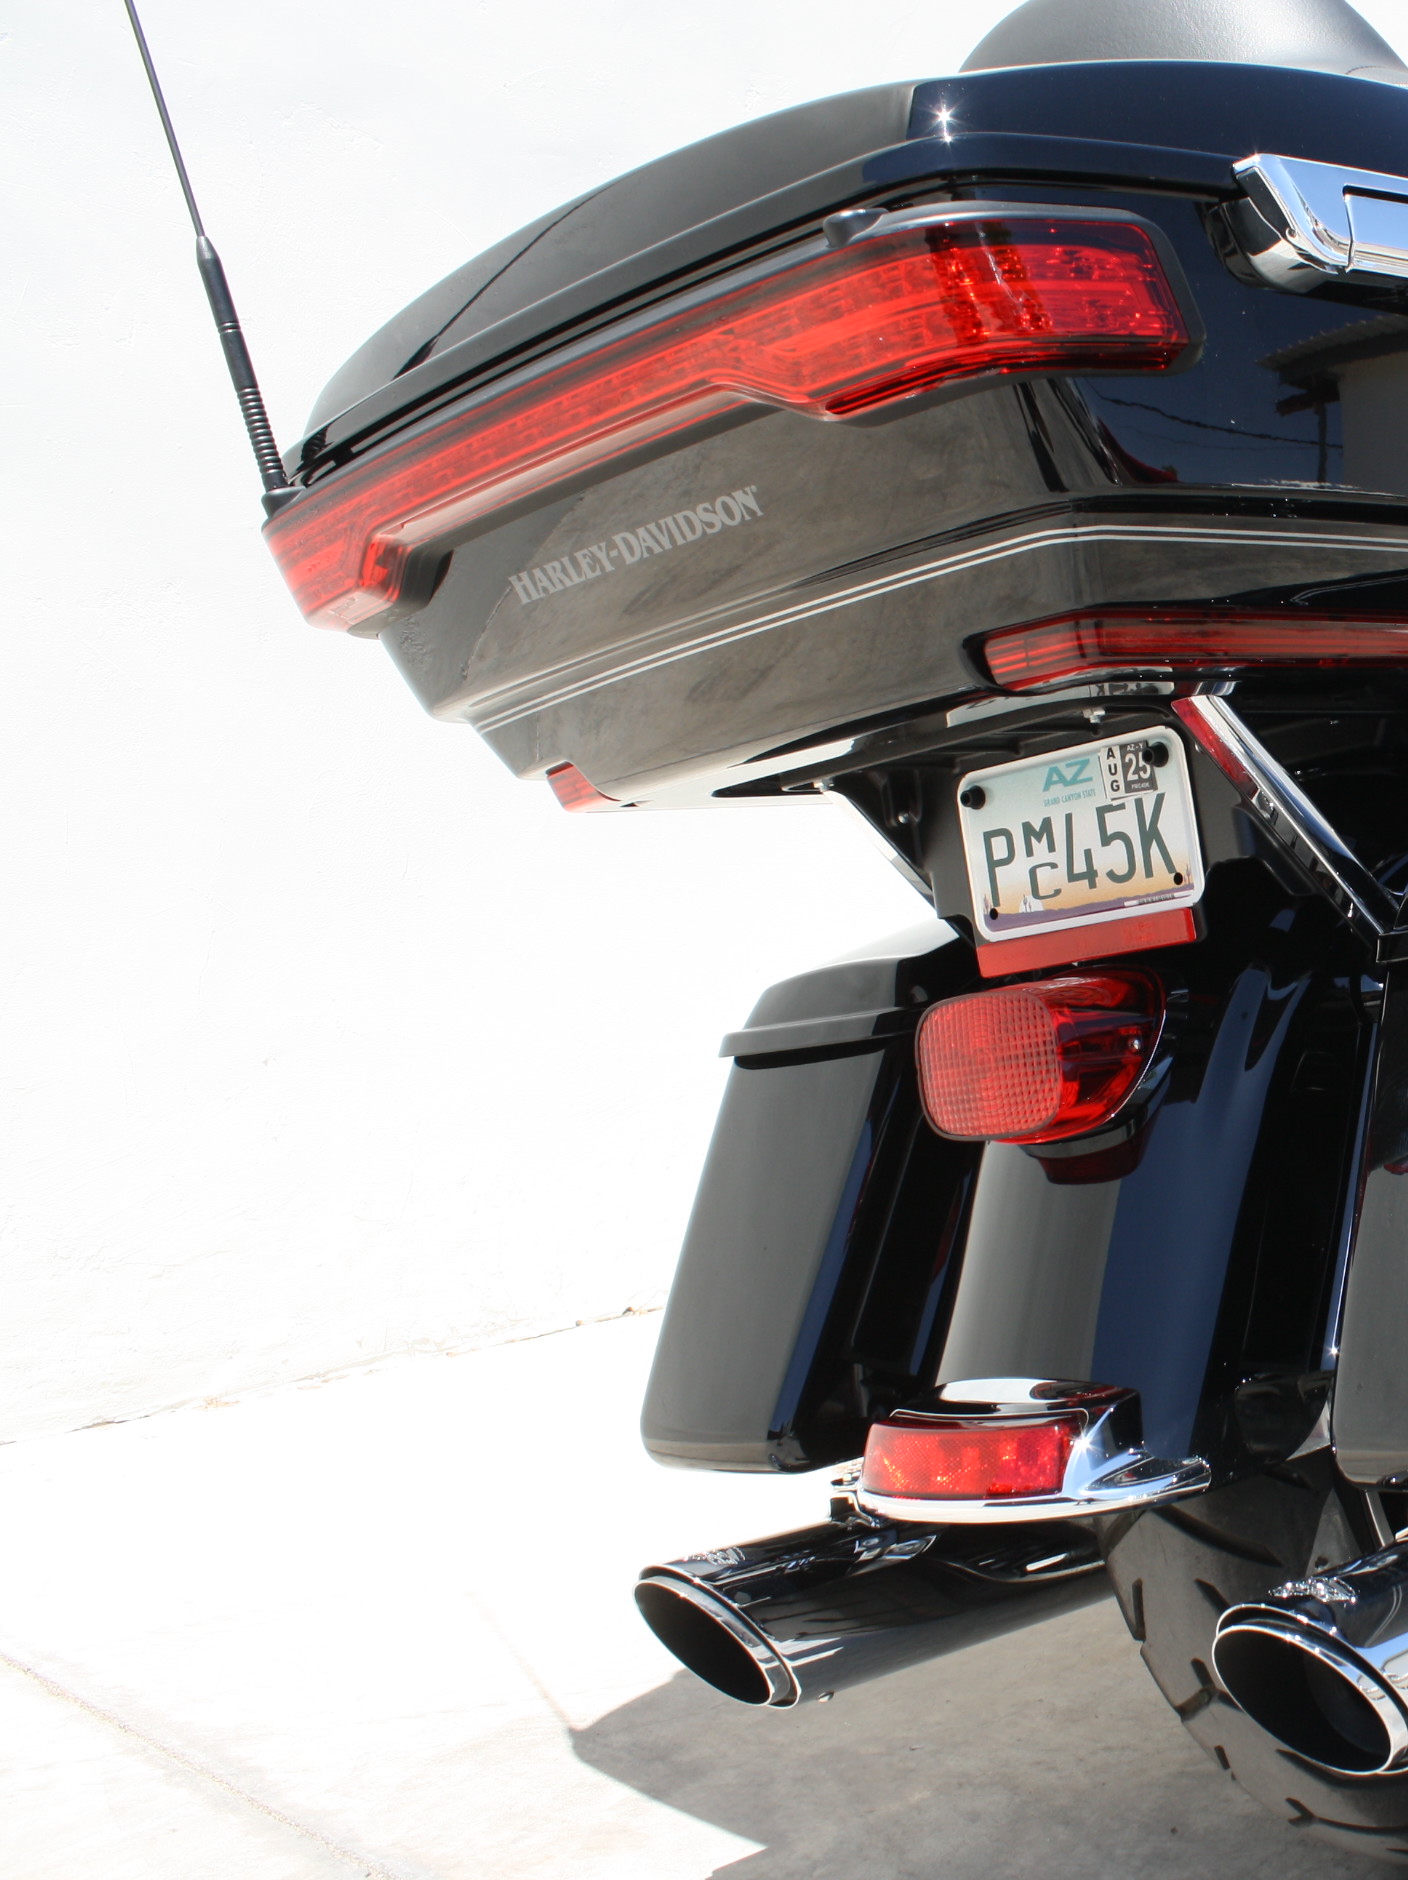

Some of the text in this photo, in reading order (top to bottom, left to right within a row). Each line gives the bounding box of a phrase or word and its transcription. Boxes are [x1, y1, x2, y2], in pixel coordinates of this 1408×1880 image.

[508, 486, 764, 605] HARLEY-DAVIDSON
[1042, 758, 1093, 792] AZ
[1107, 746, 1121, 792] AUG
[1125, 751, 1151, 781] 25
[1061, 791, 1082, 804] CANYON
[1082, 788, 1097, 799] STATE
